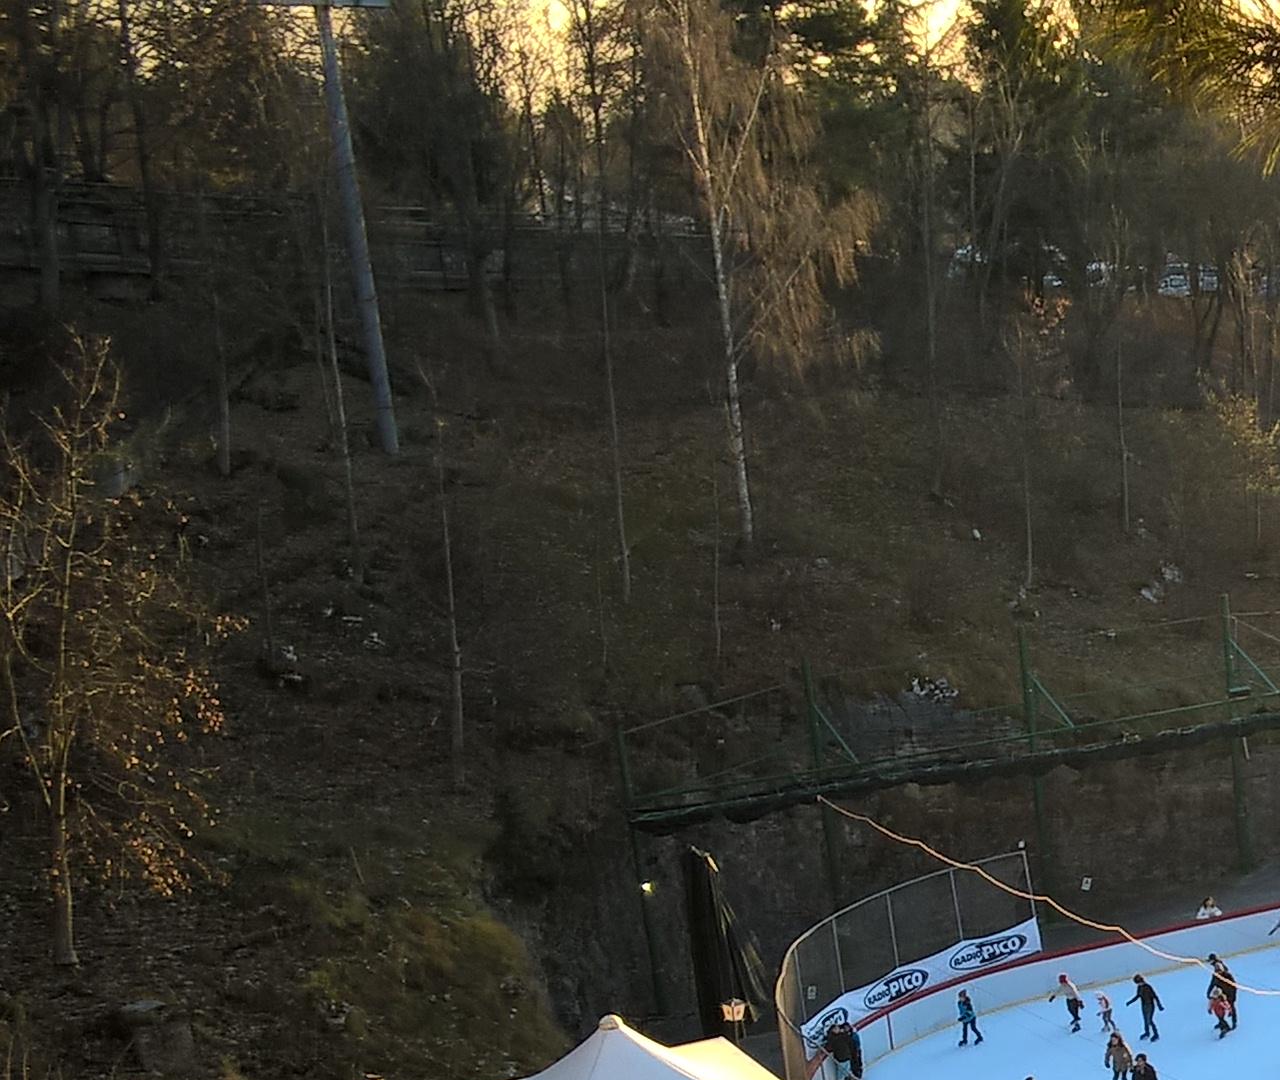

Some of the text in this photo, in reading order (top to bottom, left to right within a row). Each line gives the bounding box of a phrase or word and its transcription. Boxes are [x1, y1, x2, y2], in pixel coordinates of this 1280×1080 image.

[953, 936, 1020, 967] RADIO PICO
[867, 971, 923, 1006] RADIO PICO
